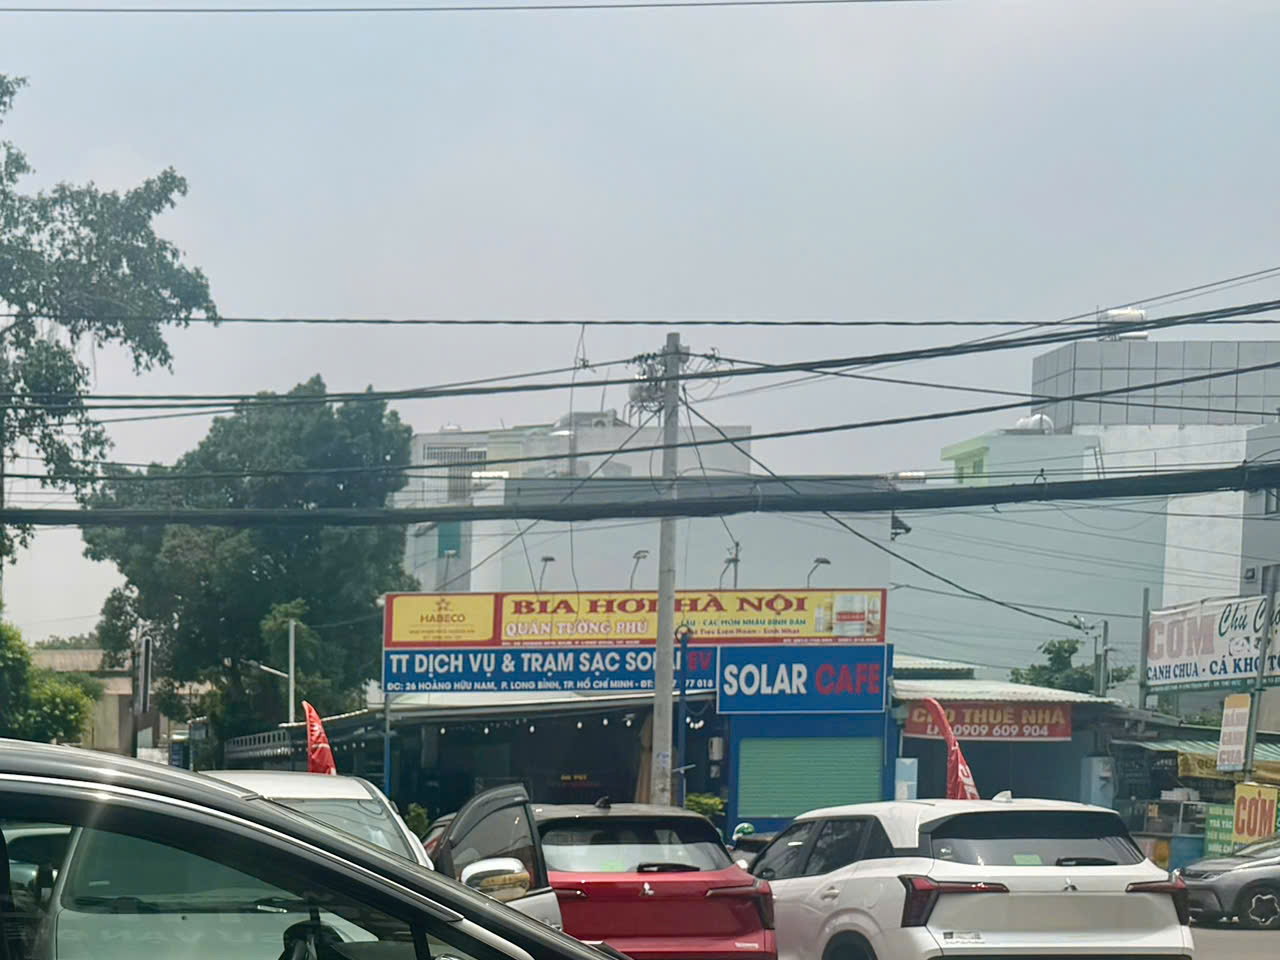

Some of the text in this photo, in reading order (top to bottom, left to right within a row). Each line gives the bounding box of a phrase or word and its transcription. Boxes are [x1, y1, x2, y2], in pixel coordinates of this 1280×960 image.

[513, 599, 577, 615] BIA
[674, 594, 728, 613] HÀ
[736, 594, 809, 616] NỘI
[420, 614, 466, 623] HABECO
[389, 654, 410, 673] TT
[415, 653, 464, 678] DỊCH
[469, 653, 496, 678] VỤ
[501, 652, 516, 673] &
[521, 652, 574, 677] TRẠM
[579, 651, 620, 677] SẠC
[1146, 665, 1172, 681] CANH
[1173, 662, 1199, 679] CHUA
[1209, 655, 1229, 676] CÁ
[405, 682, 417, 691] 26
[418, 679, 453, 691] HOÀNG
[510, 680, 536, 690] LONG
[610, 680, 634, 689] MINH
[723, 663, 881, 696] SOLAR CAFE
[954, 724, 989, 736] 0909
[992, 725, 1019, 736] 609
[1022, 725, 1049, 736] 904
[1234, 789, 1276, 838] CƠM
